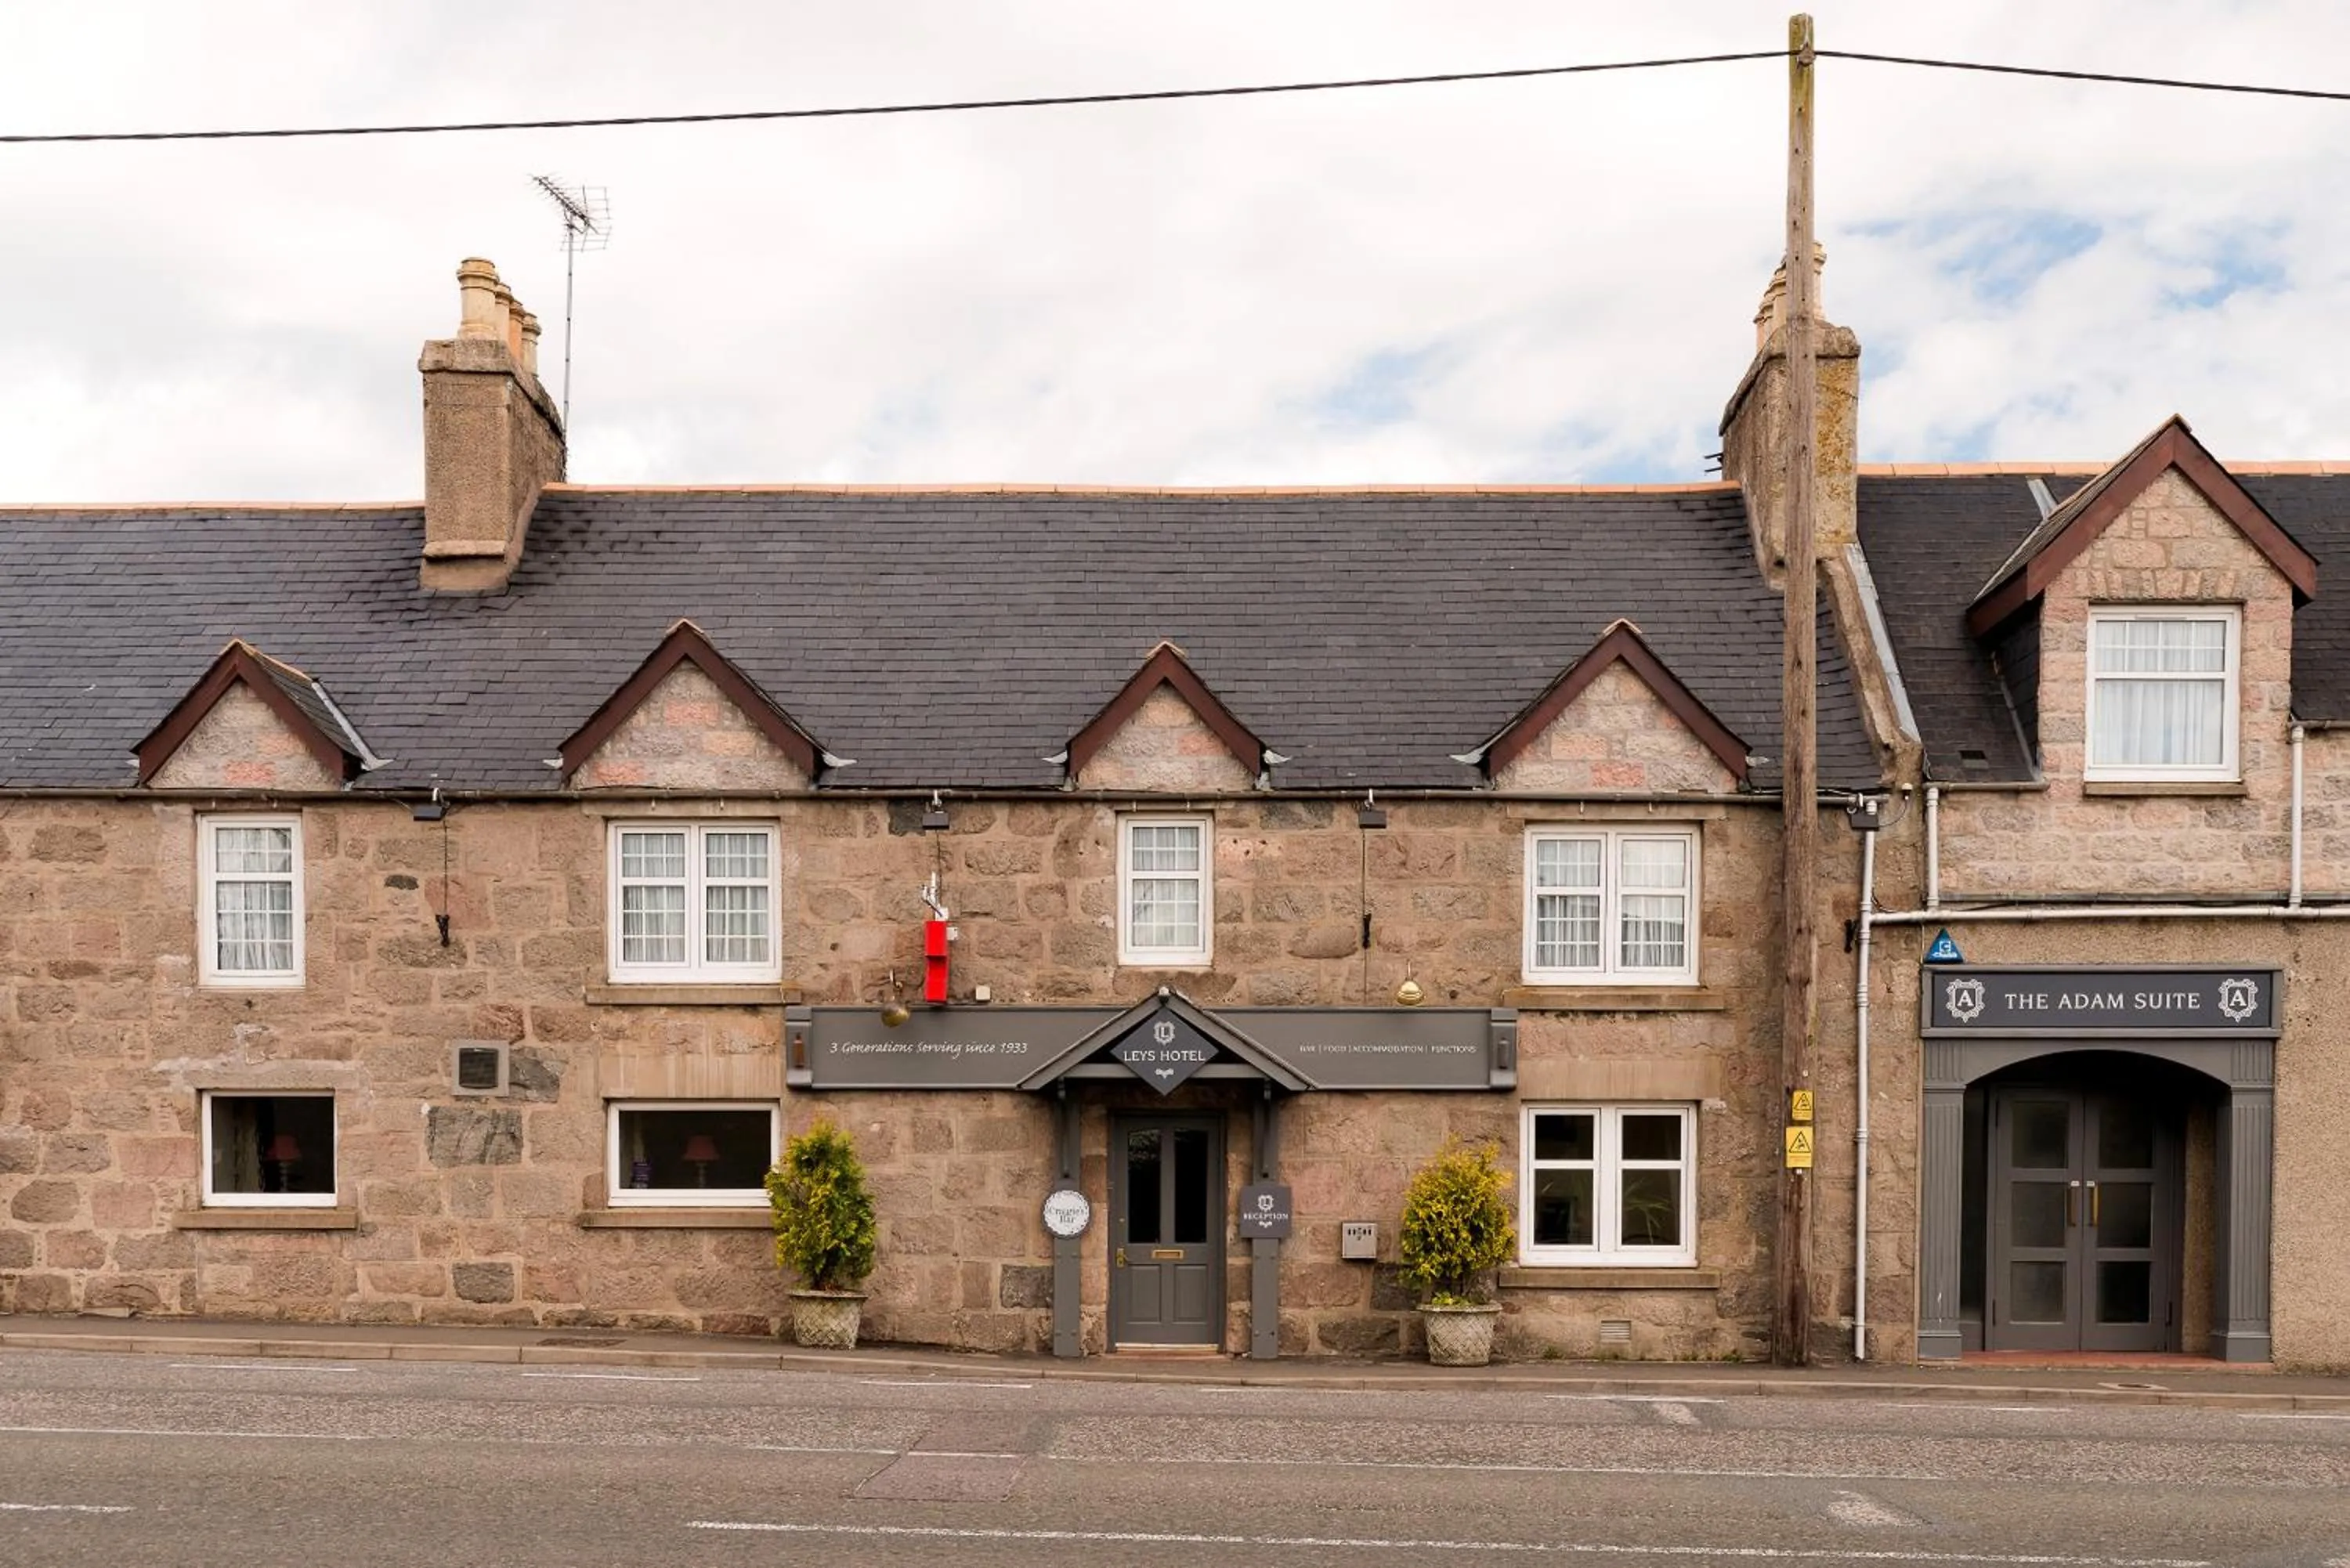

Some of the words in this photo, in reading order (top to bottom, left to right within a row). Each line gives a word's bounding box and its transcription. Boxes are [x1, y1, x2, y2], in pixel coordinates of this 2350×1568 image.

[1957, 989, 1974, 1006] A
[2005, 993, 2048, 1010] THE
[2058, 993, 2124, 1010] ADAM
[2135, 992, 2200, 1010] SUITE
[2229, 988, 2247, 1006] A
[830, 1042, 837, 1053] 3
[842, 1041, 913, 1054] Generations
[965, 1041, 996, 1053] since
[1000, 1042, 1028, 1054] 1933
[1352, 1046, 1423, 1054] ACCOMMODATION
[1431, 1046, 1477, 1054] FUNCTIONS
[1123, 1050, 1155, 1061] LEYS
[1160, 1050, 1206, 1061] HOTEL
